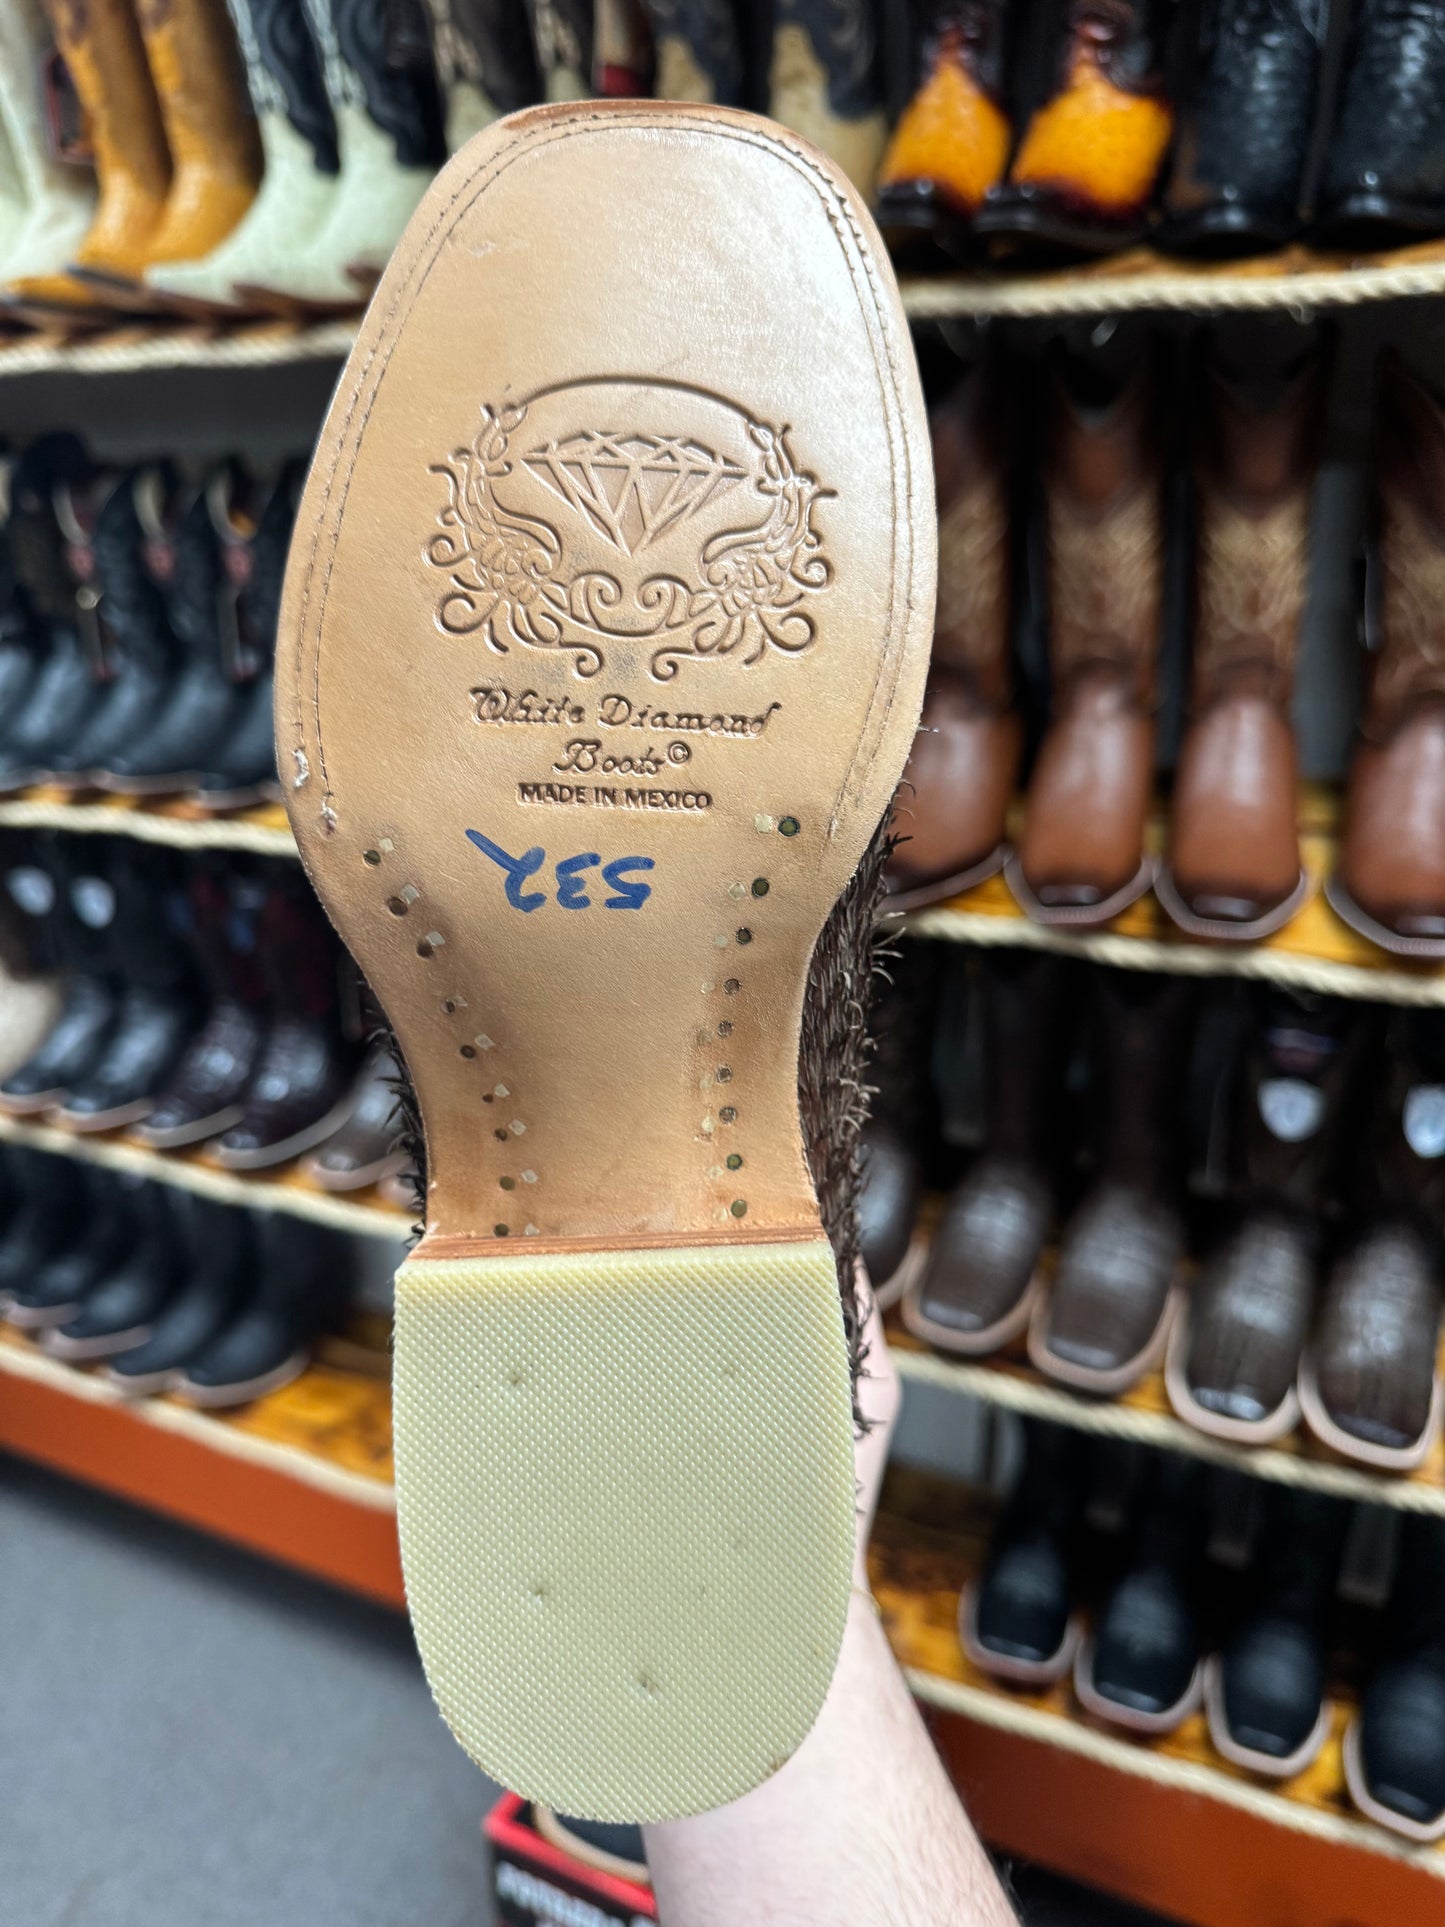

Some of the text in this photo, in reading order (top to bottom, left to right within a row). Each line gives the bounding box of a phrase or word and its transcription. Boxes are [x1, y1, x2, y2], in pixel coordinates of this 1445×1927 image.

[469, 686, 782, 738] White Diamond
[517, 781, 713, 812] MADE IN MEXICO
